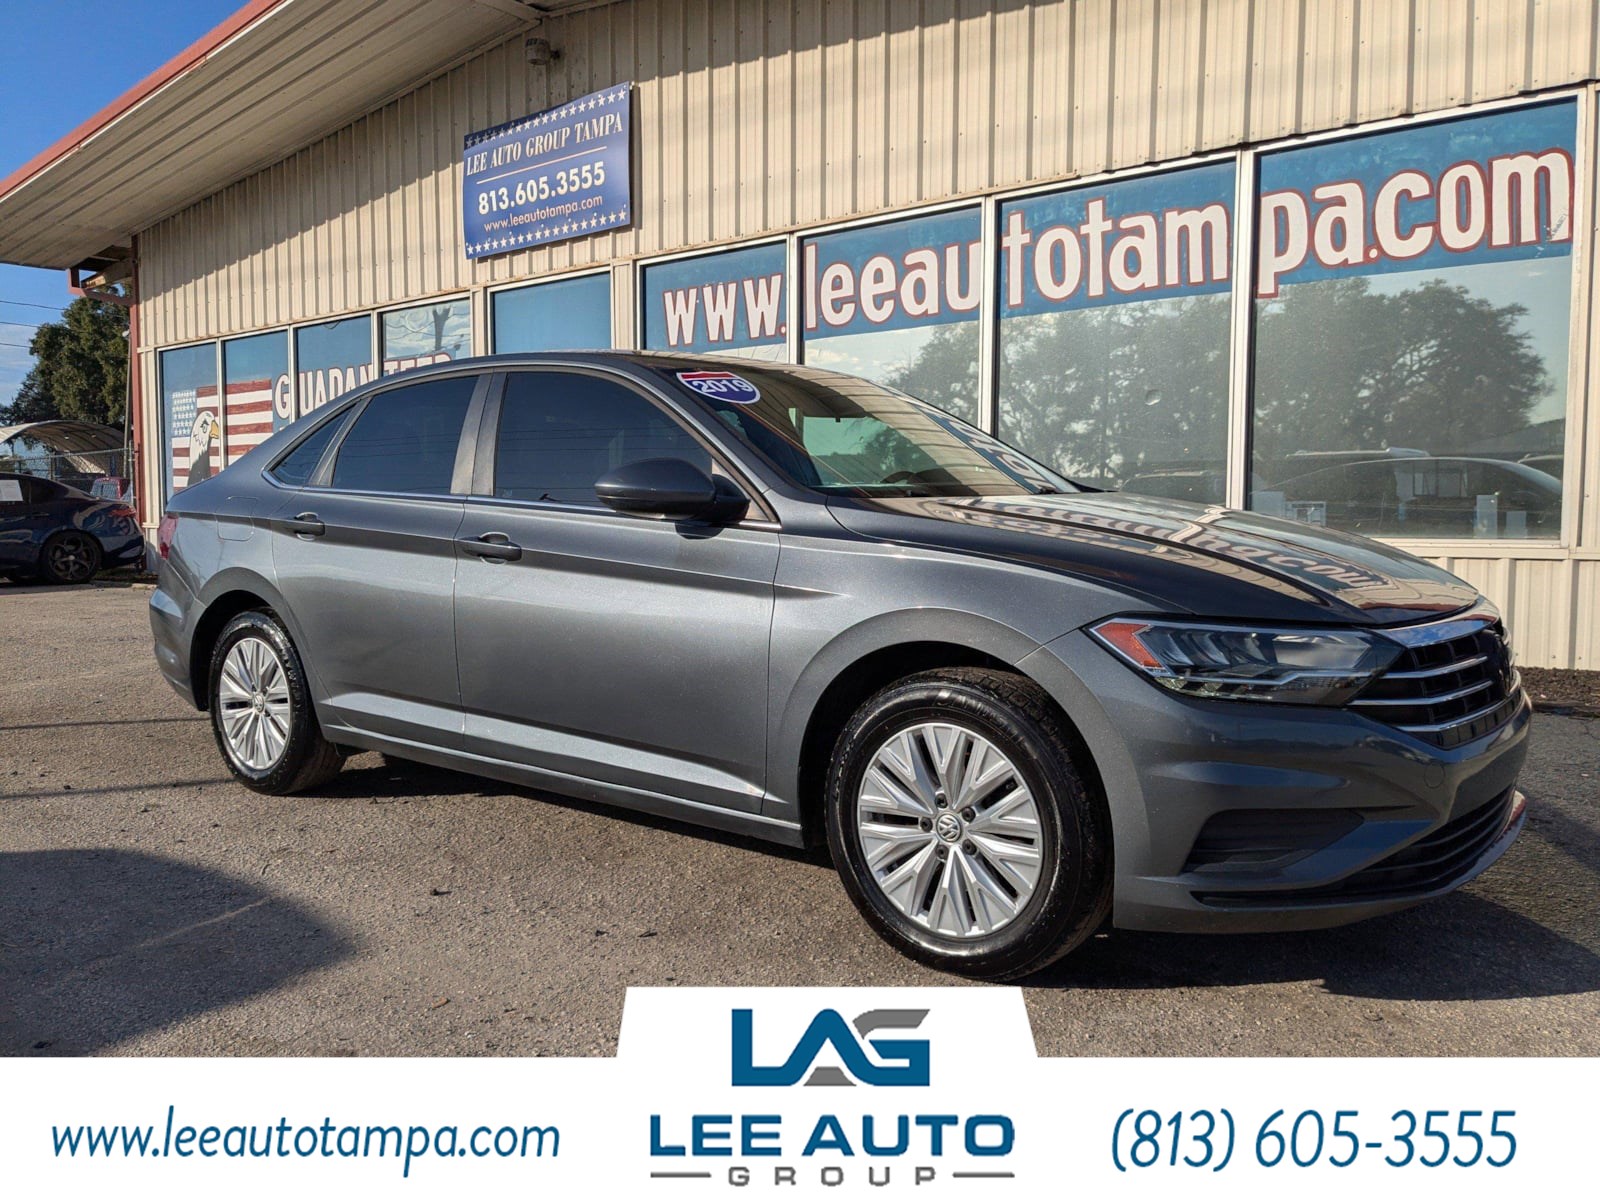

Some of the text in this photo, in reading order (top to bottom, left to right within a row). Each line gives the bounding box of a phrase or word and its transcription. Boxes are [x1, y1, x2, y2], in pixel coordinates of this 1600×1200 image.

[466, 112, 623, 176] LEE AUTO GROUP TAMPA
[478, 161, 606, 215] 813.605.3555
[484, 195, 603, 232] www.leeautotampa.com
[692, 380, 753, 393] 2019
